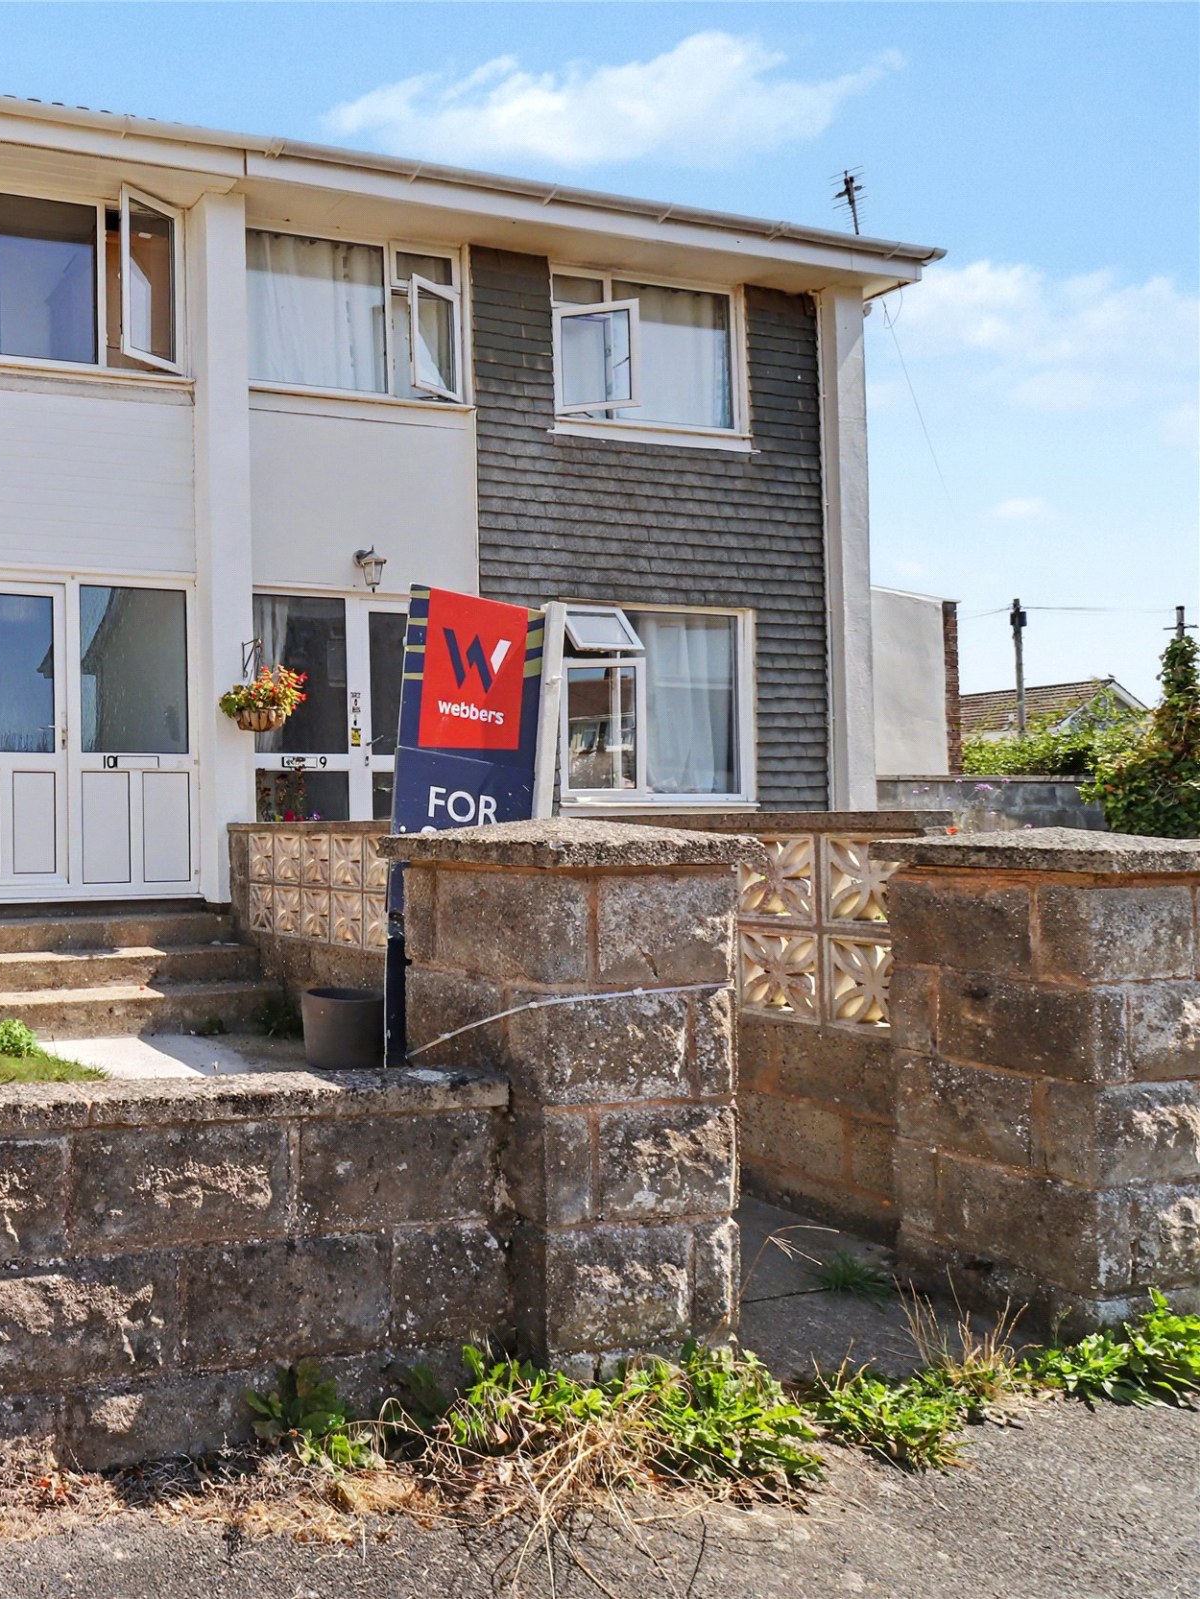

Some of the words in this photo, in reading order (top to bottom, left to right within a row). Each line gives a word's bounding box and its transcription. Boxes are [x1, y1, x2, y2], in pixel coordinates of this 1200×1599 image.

[437, 699, 504, 725] webbers
[319, 756, 327, 768] 9
[427, 785, 498, 825] FOR
